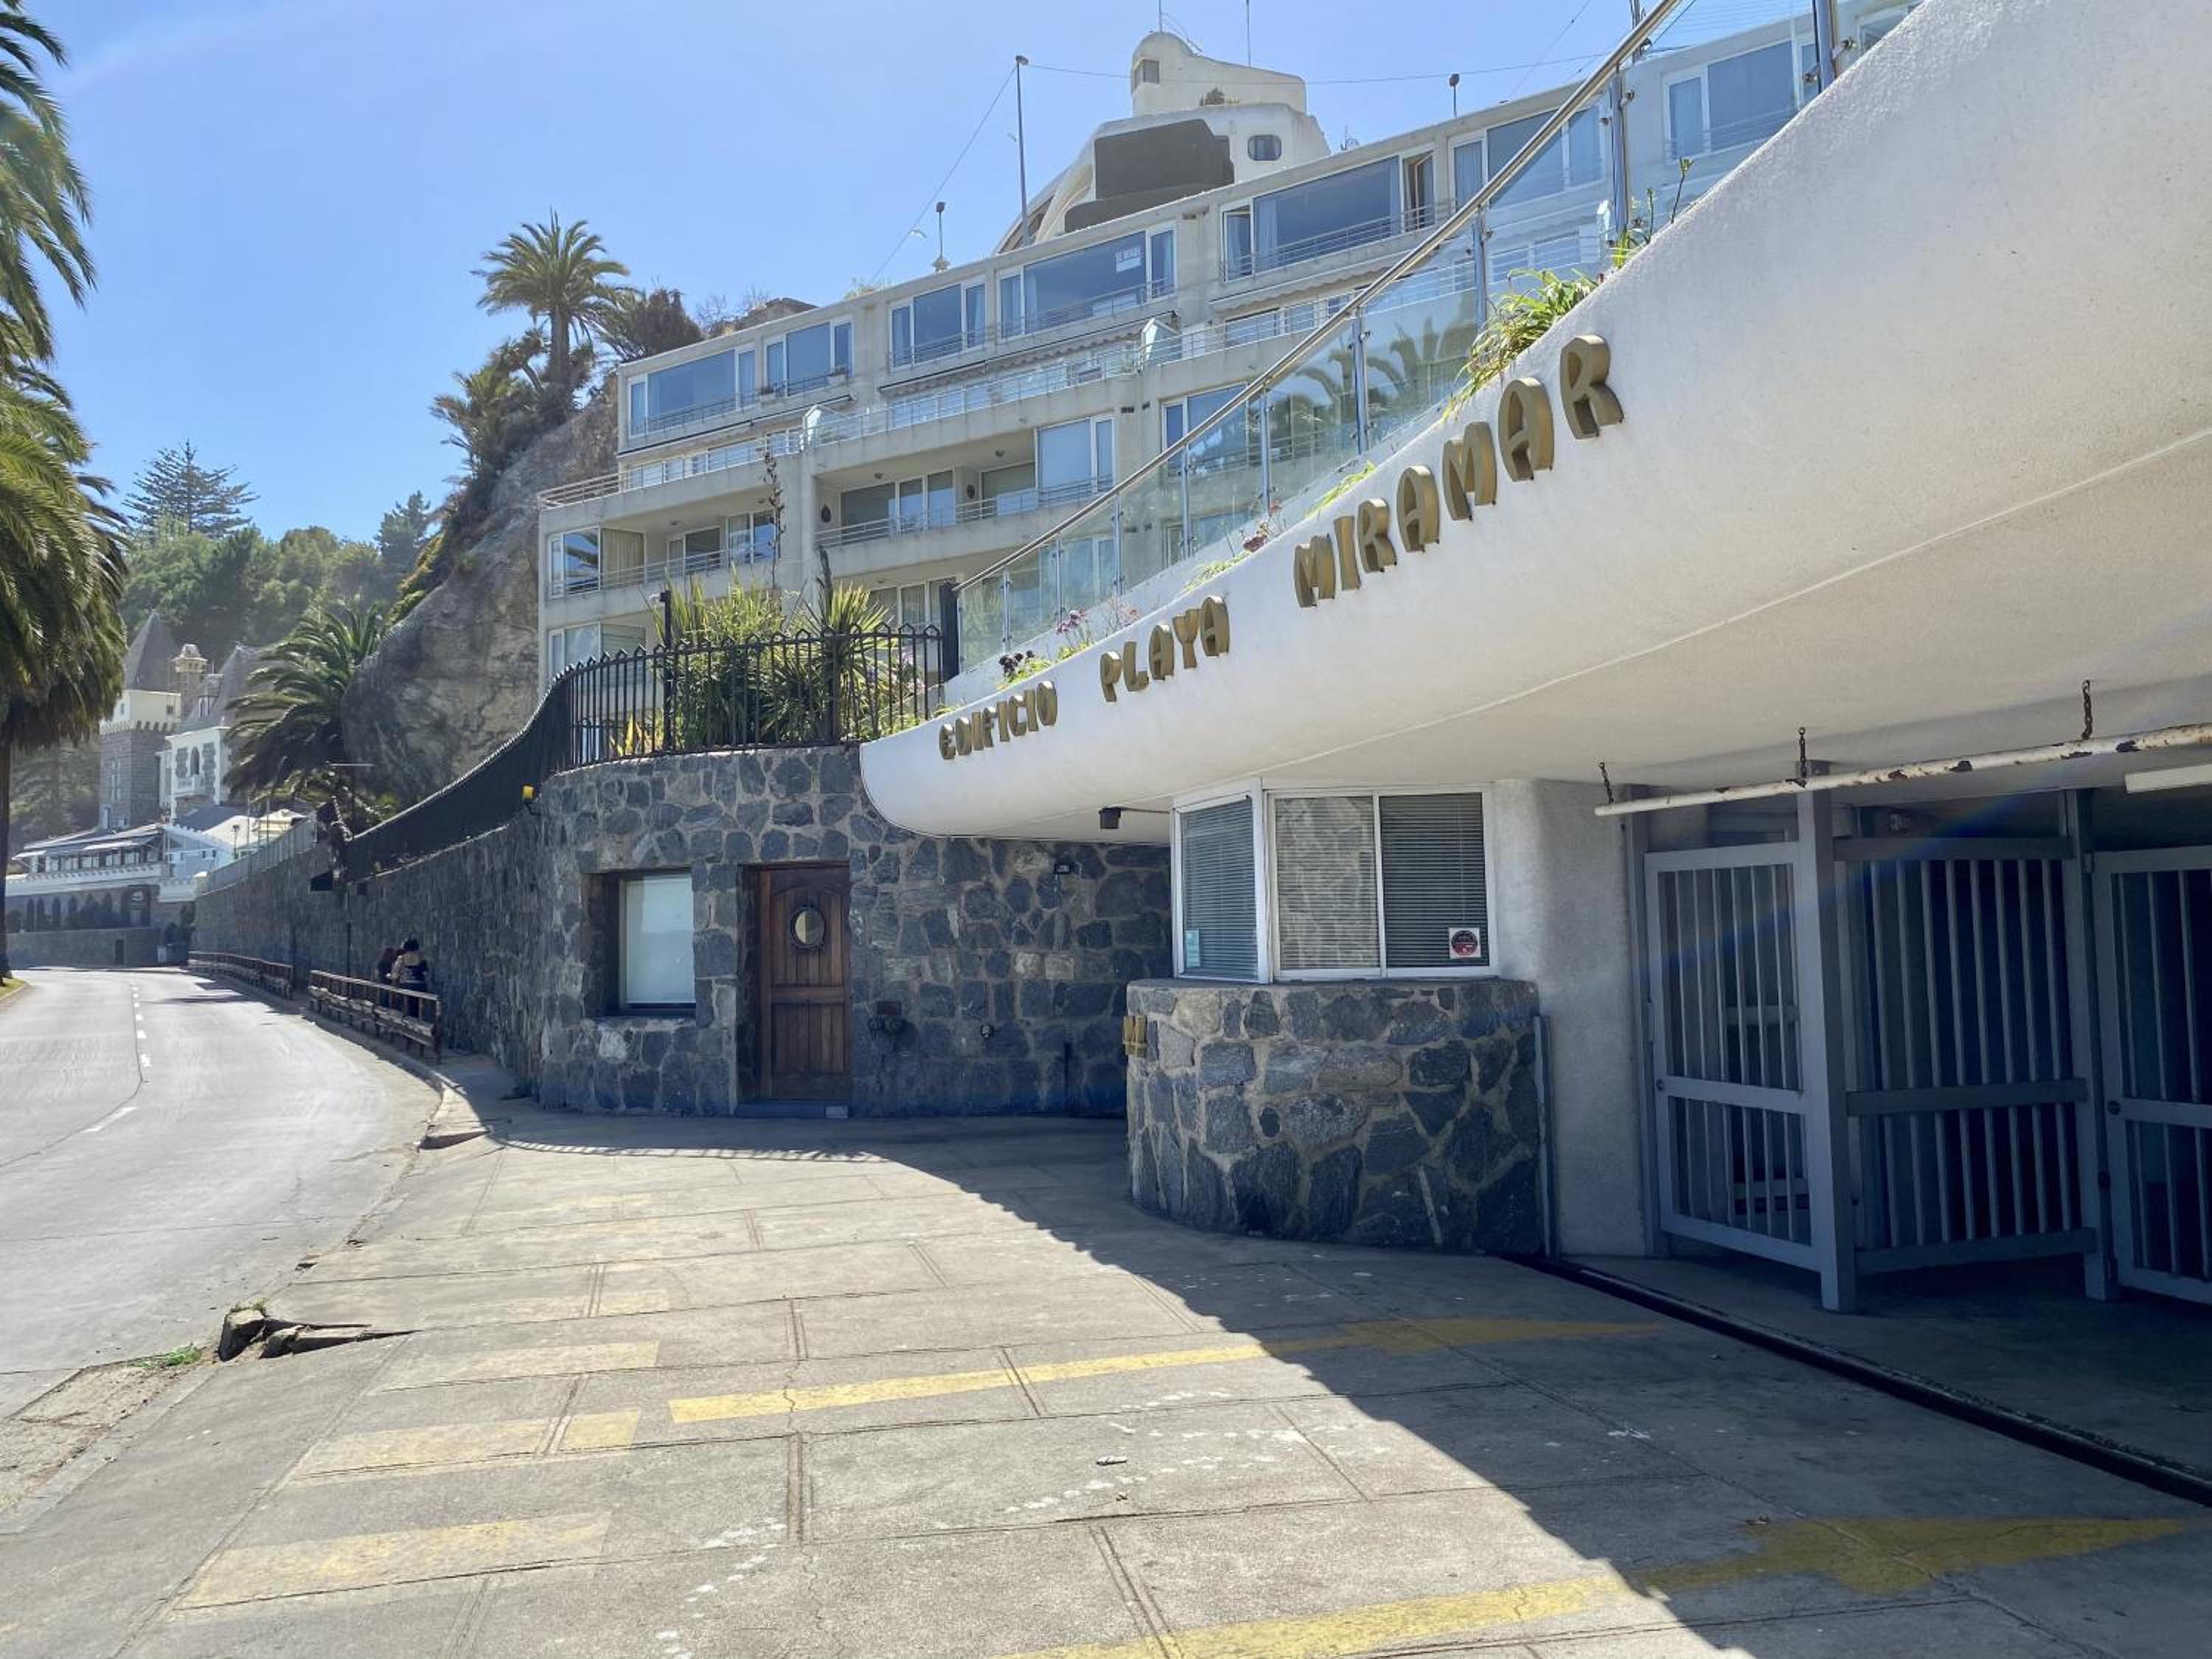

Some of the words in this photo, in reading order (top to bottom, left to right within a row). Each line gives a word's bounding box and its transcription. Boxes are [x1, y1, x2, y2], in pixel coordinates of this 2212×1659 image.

[939, 681, 1058, 759] EDIFICIO
[1099, 595, 1231, 702] PLAYA
[1293, 334, 1624, 608] MIRAMAR
